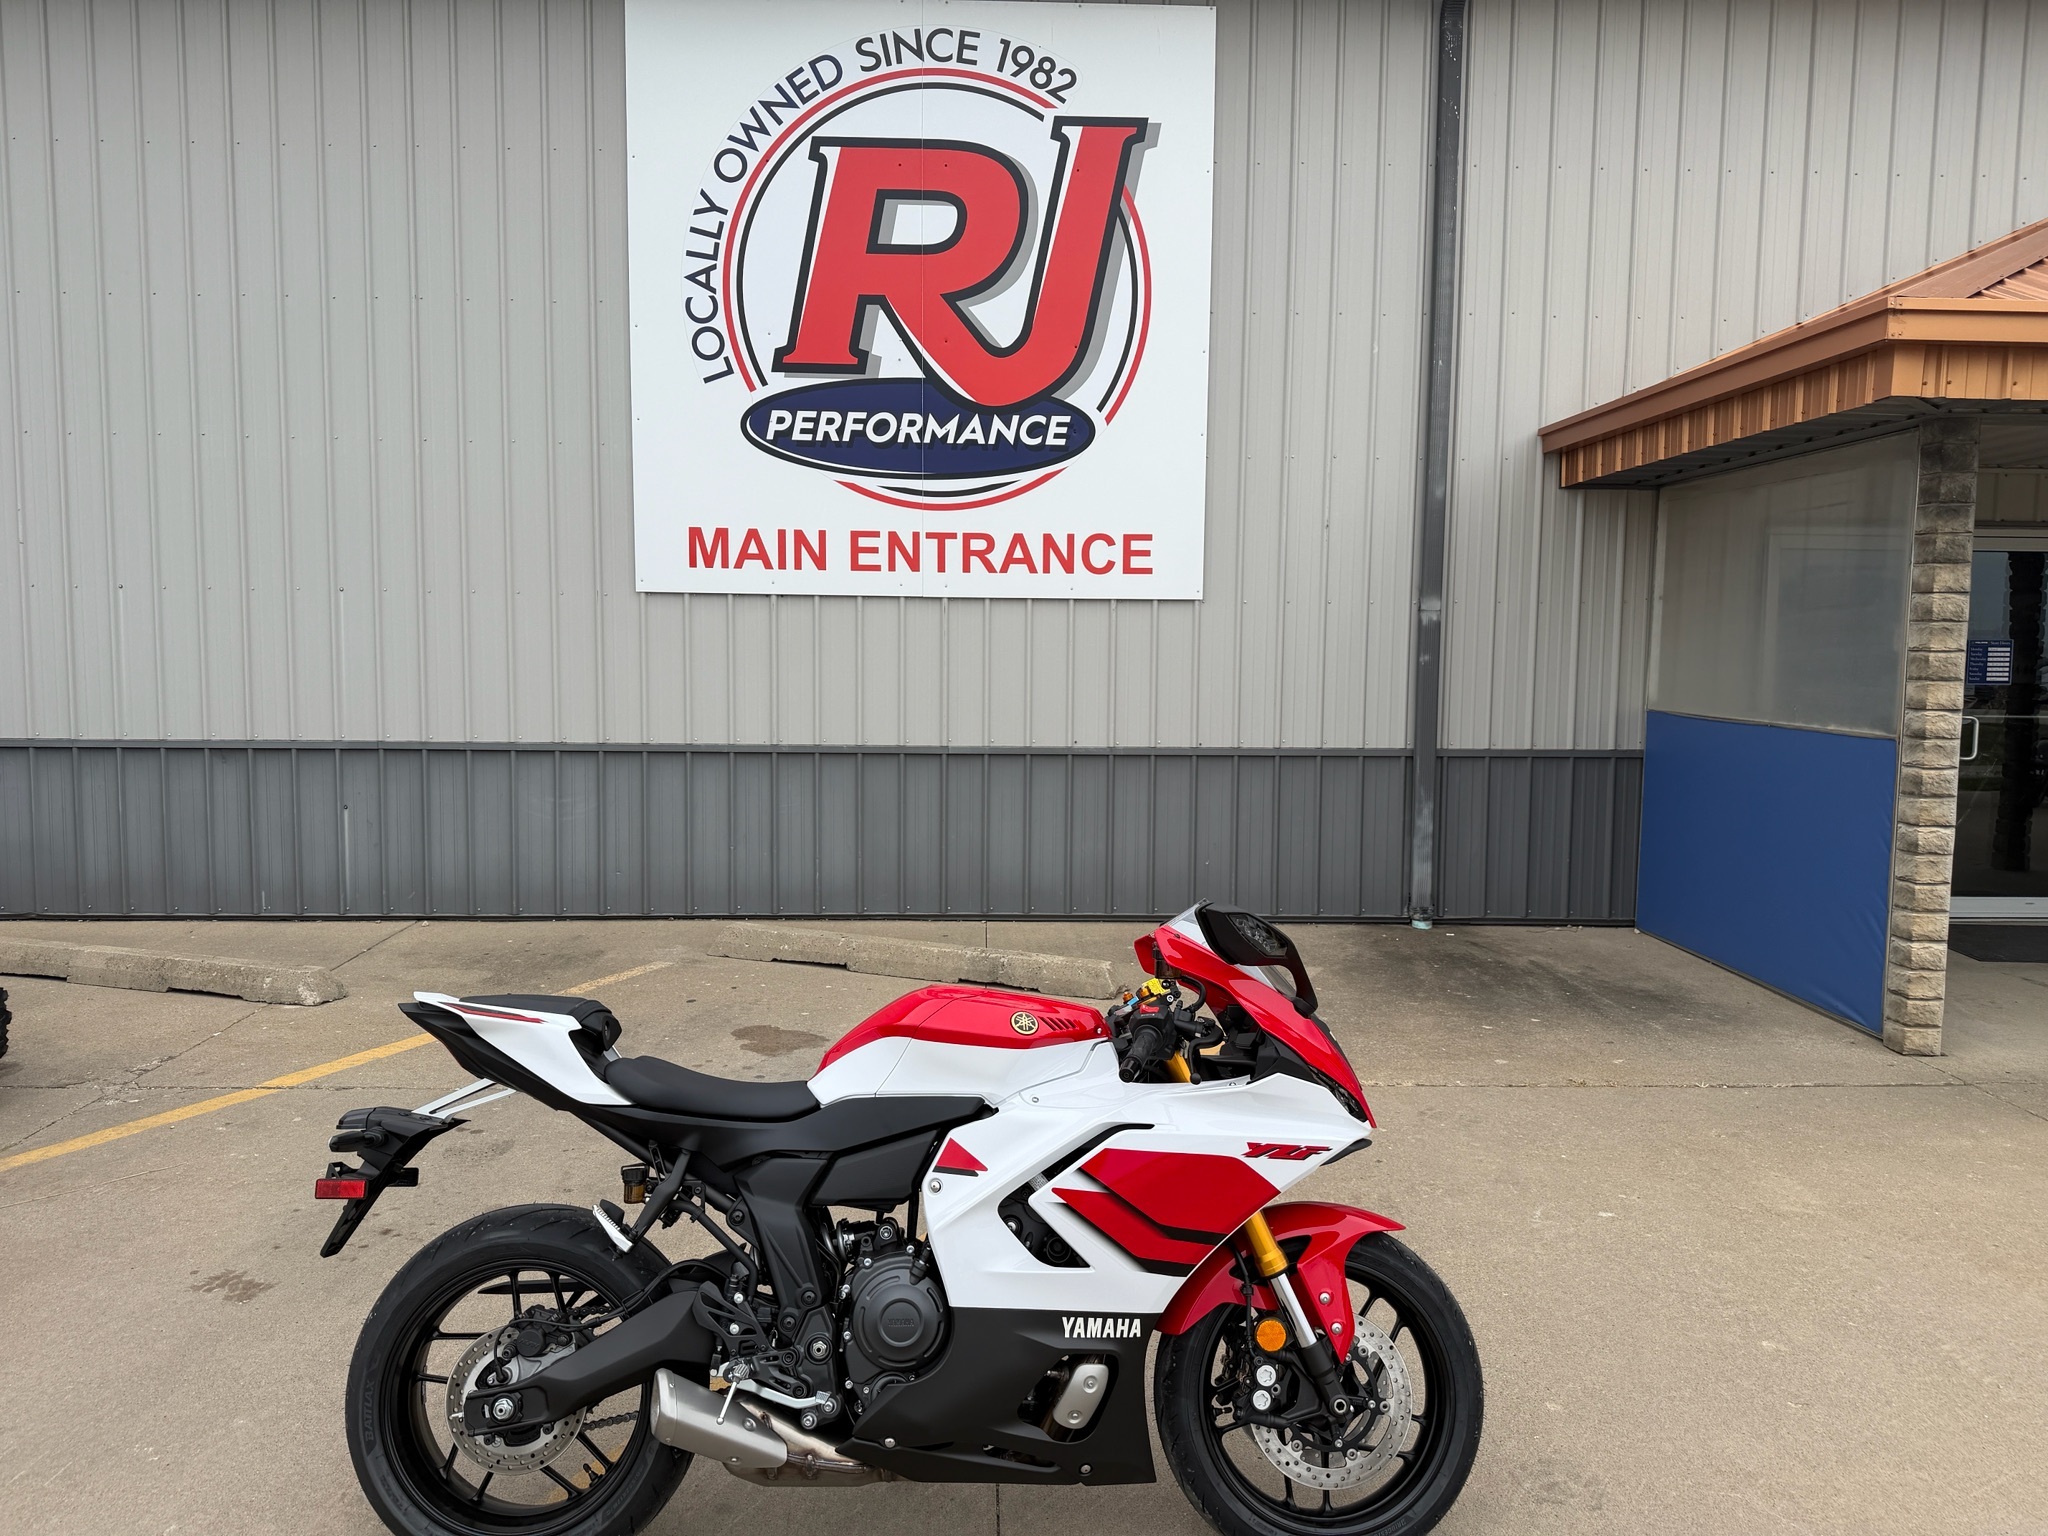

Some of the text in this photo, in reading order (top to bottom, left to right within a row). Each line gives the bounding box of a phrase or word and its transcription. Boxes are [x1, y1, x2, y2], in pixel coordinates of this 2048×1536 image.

[684, 28, 1077, 383] LOCALLY OWNED SINCE 1982
[771, 117, 1149, 412] RJ
[766, 410, 1071, 446] PERFORMANCE
[688, 526, 1153, 575] MAIN ENTRANCE
[1062, 1316, 1141, 1338] YAMAHA
[364, 1380, 376, 1442] BATTLAX
